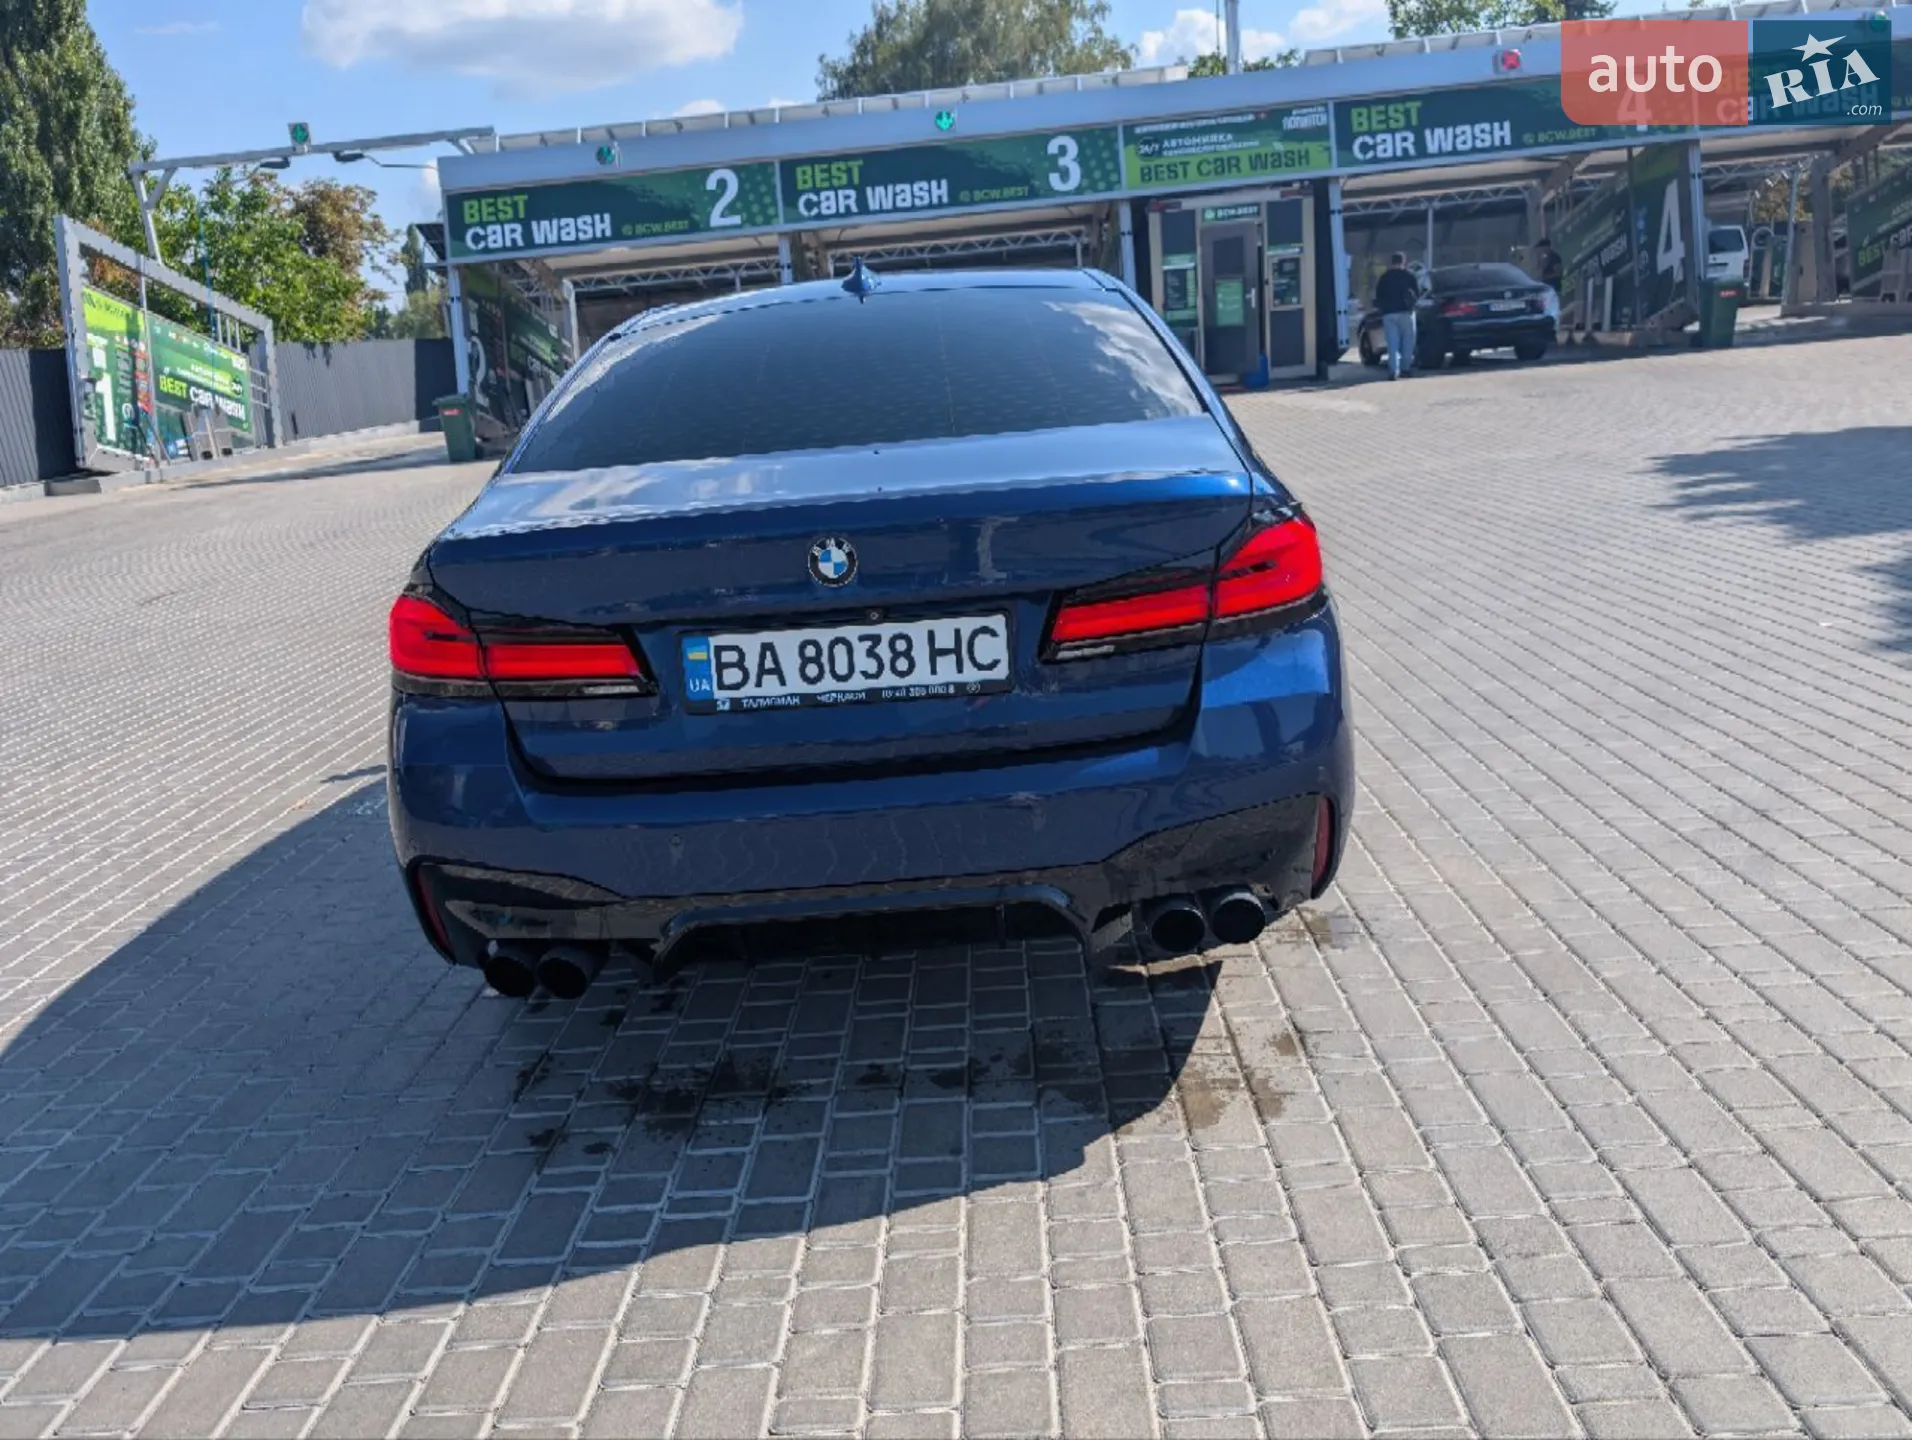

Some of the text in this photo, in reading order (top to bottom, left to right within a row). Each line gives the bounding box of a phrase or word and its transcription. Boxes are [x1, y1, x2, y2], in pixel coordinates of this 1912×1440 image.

[1351, 101, 1422, 132] BEST
[796, 160, 864, 190] BEST
[1046, 135, 1081, 192] 3
[1140, 160, 1191, 183] BEST
[463, 194, 529, 224] BEST
[705, 168, 742, 228] 2
[160, 374, 188, 399] BEST
[714, 625, 1001, 691] BA 8038 HC
[690, 678, 713, 693] UA
